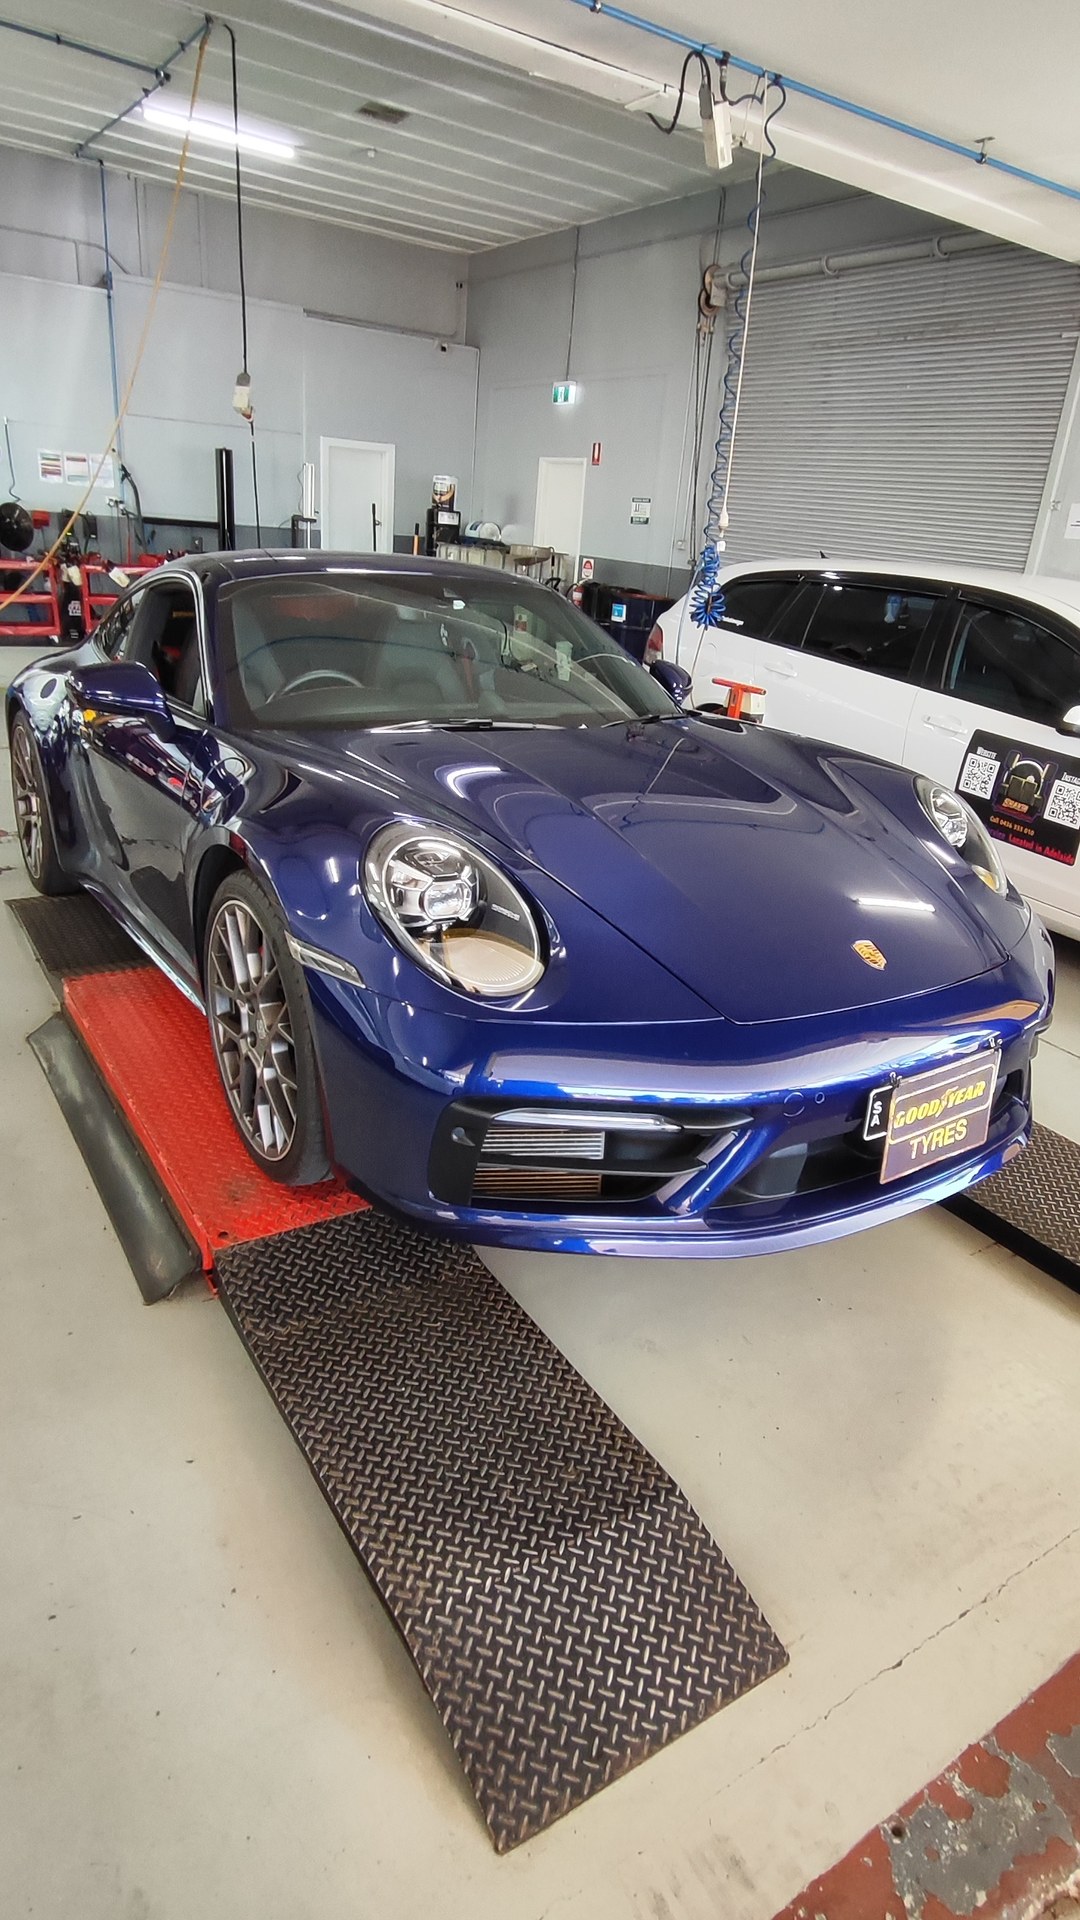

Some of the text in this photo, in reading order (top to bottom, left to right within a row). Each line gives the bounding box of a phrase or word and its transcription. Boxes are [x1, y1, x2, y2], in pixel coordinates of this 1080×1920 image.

[1008, 833, 1035, 850] Located
[1035, 844, 1043, 853] in
[1043, 846, 1075, 865] Adelaide
[893, 1080, 987, 1129] GOODYEAR
[909, 1118, 968, 1159] TYRES
